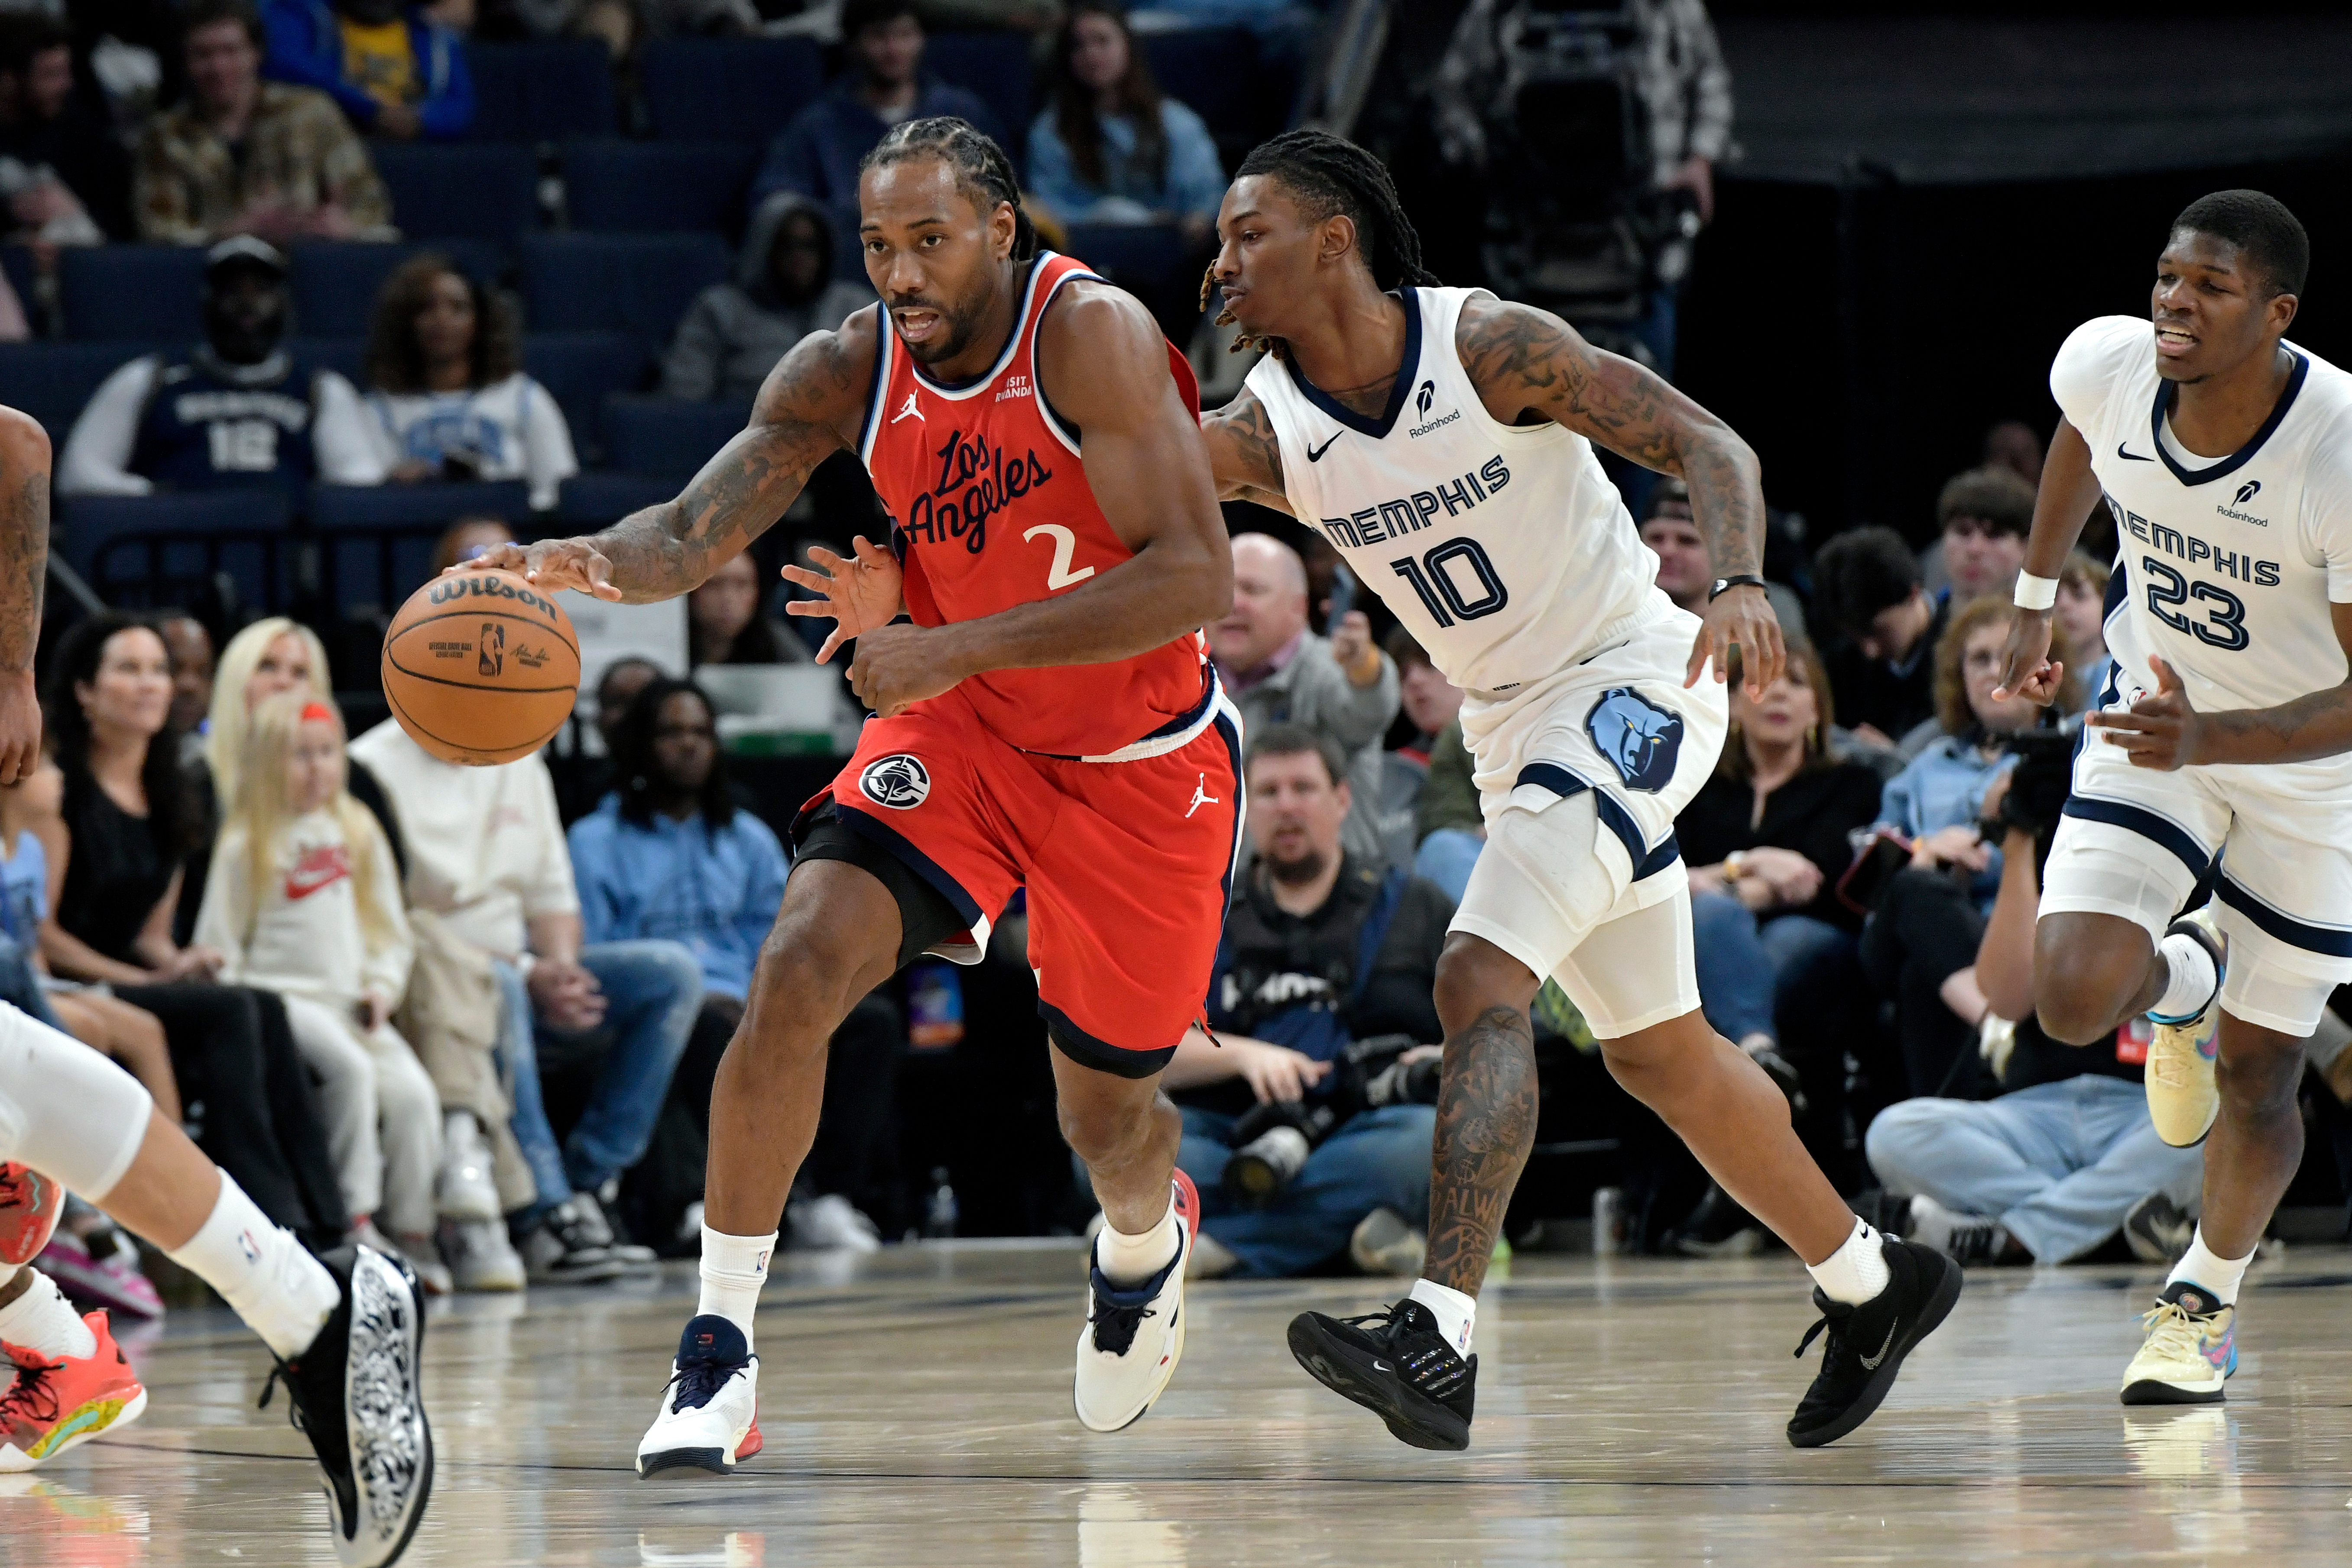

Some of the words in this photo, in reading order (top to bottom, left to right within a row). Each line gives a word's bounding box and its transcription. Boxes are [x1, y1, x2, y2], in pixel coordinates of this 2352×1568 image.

[1005, 376, 1027, 388] ISIT
[1409, 409, 1461, 439] Robinhood
[937, 430, 990, 498] Los
[904, 447, 1052, 555] Angeles
[1320, 454, 1511, 548] MEMPHIS
[2216, 505, 2268, 528] Robinhood
[1022, 523, 1095, 591] 2
[2102, 487, 2281, 587] MEMPHIS
[428, 576, 557, 622] Wilson
[1389, 537, 1509, 629] 10
[2143, 555, 2250, 651] 23
